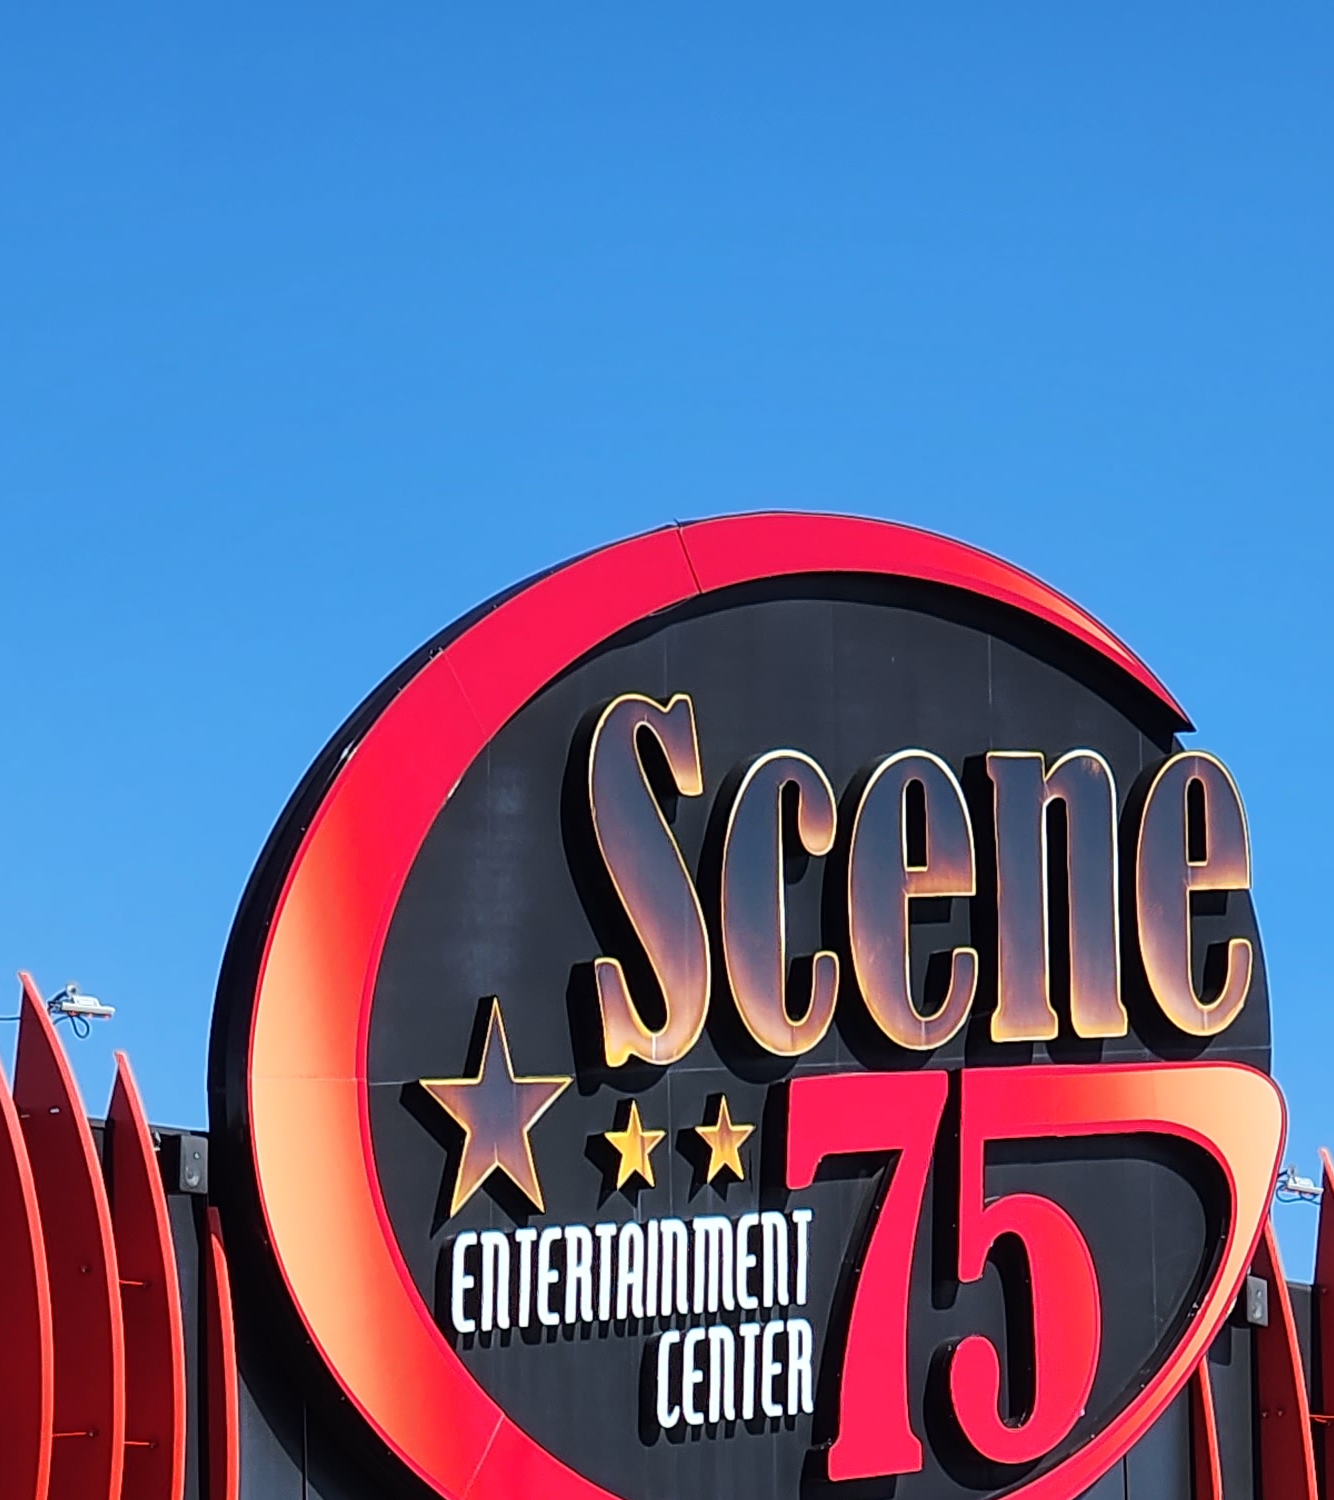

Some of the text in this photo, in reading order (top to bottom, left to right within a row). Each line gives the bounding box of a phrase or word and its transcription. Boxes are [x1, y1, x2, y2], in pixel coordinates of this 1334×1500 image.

[588, 692, 1253, 1067] Scene
[451, 1208, 813, 1334] ENTERTAINMENT
[656, 1317, 814, 1429] CENTER
[786, 1062, 1112, 1482] 75
